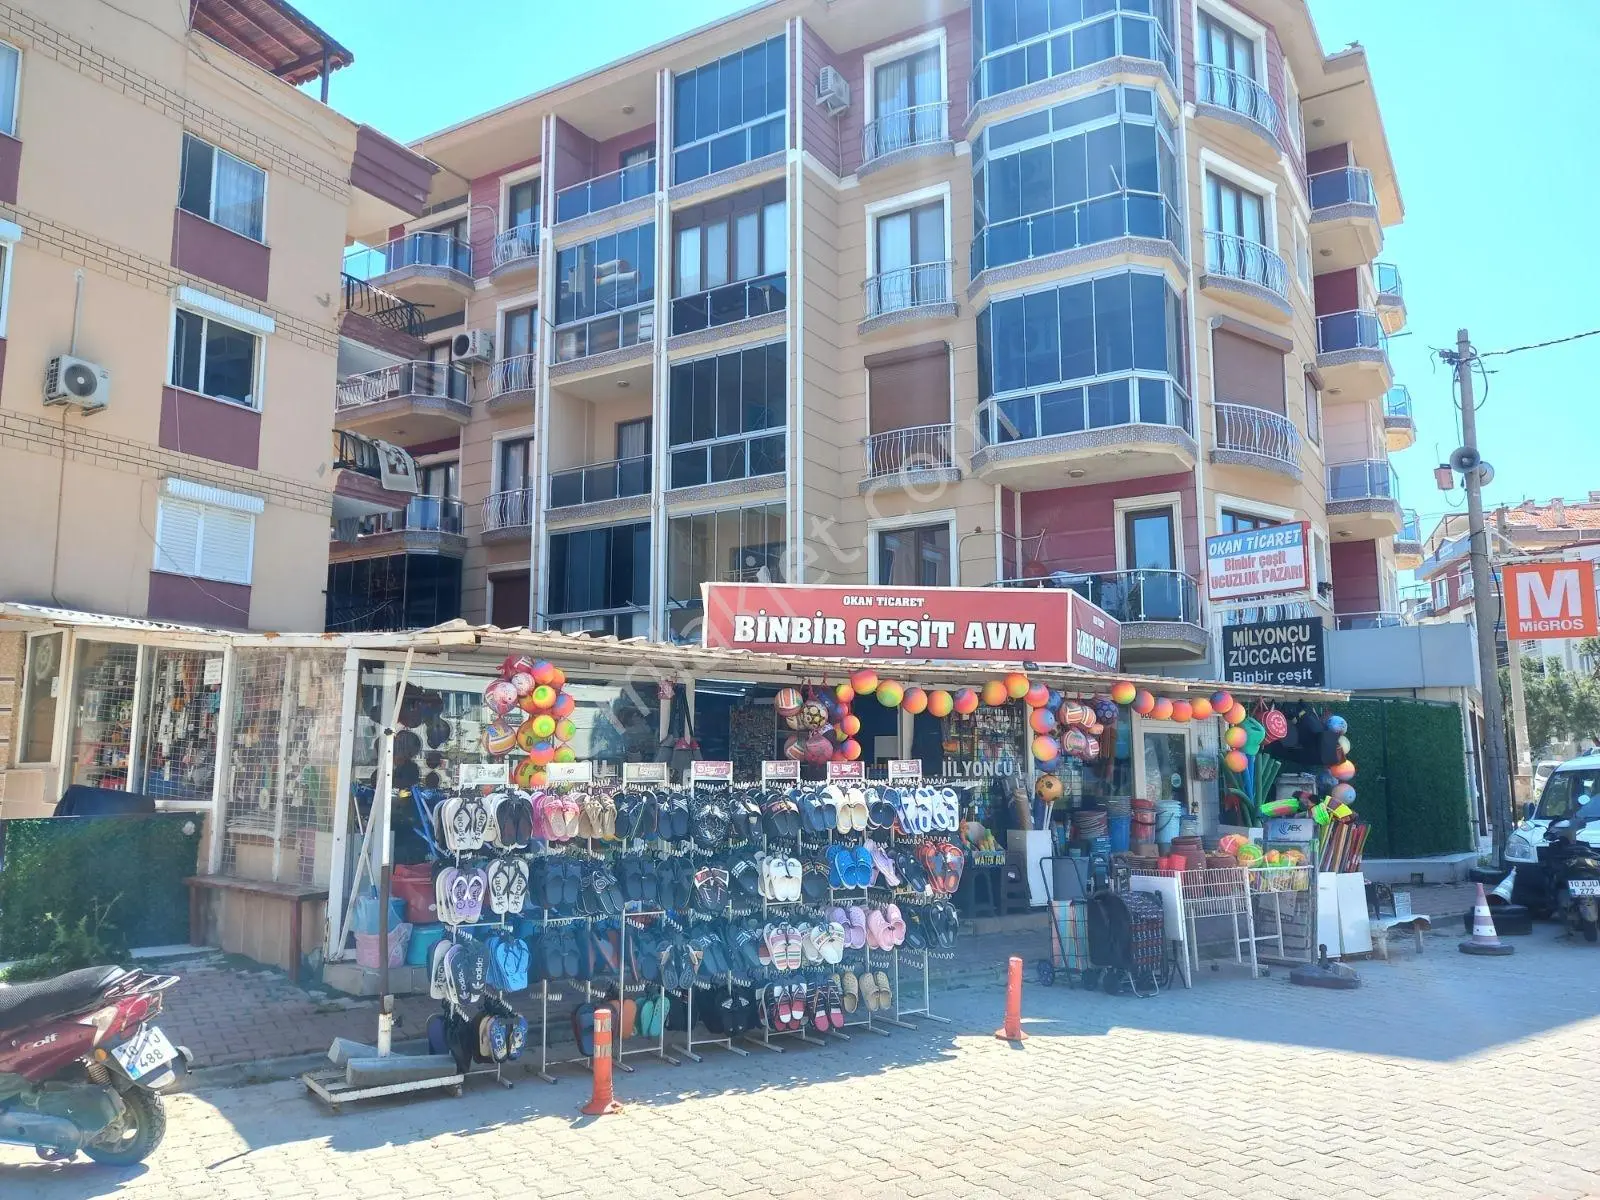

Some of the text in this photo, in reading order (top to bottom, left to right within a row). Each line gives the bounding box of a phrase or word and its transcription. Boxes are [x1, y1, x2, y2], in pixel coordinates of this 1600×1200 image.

[1209, 528, 1302, 556] OKAN TİCARET
[1224, 550, 1287, 572] Binbir çeşit
[1210, 565, 1303, 590] UCUZLUK PAZARI
[843, 594, 925, 608] OKAN TİCARET
[1515, 568, 1583, 619] M
[733, 608, 847, 646] BİNBİR
[856, 613, 956, 655] ÇEŞİT
[962, 621, 1038, 652] AVM
[1232, 624, 1311, 647] MİLYONCU
[1228, 642, 1317, 667] ZÜCCACİYE
[1232, 668, 1313, 685] Binbir çeşit
[140, 1048, 165, 1068] 488
